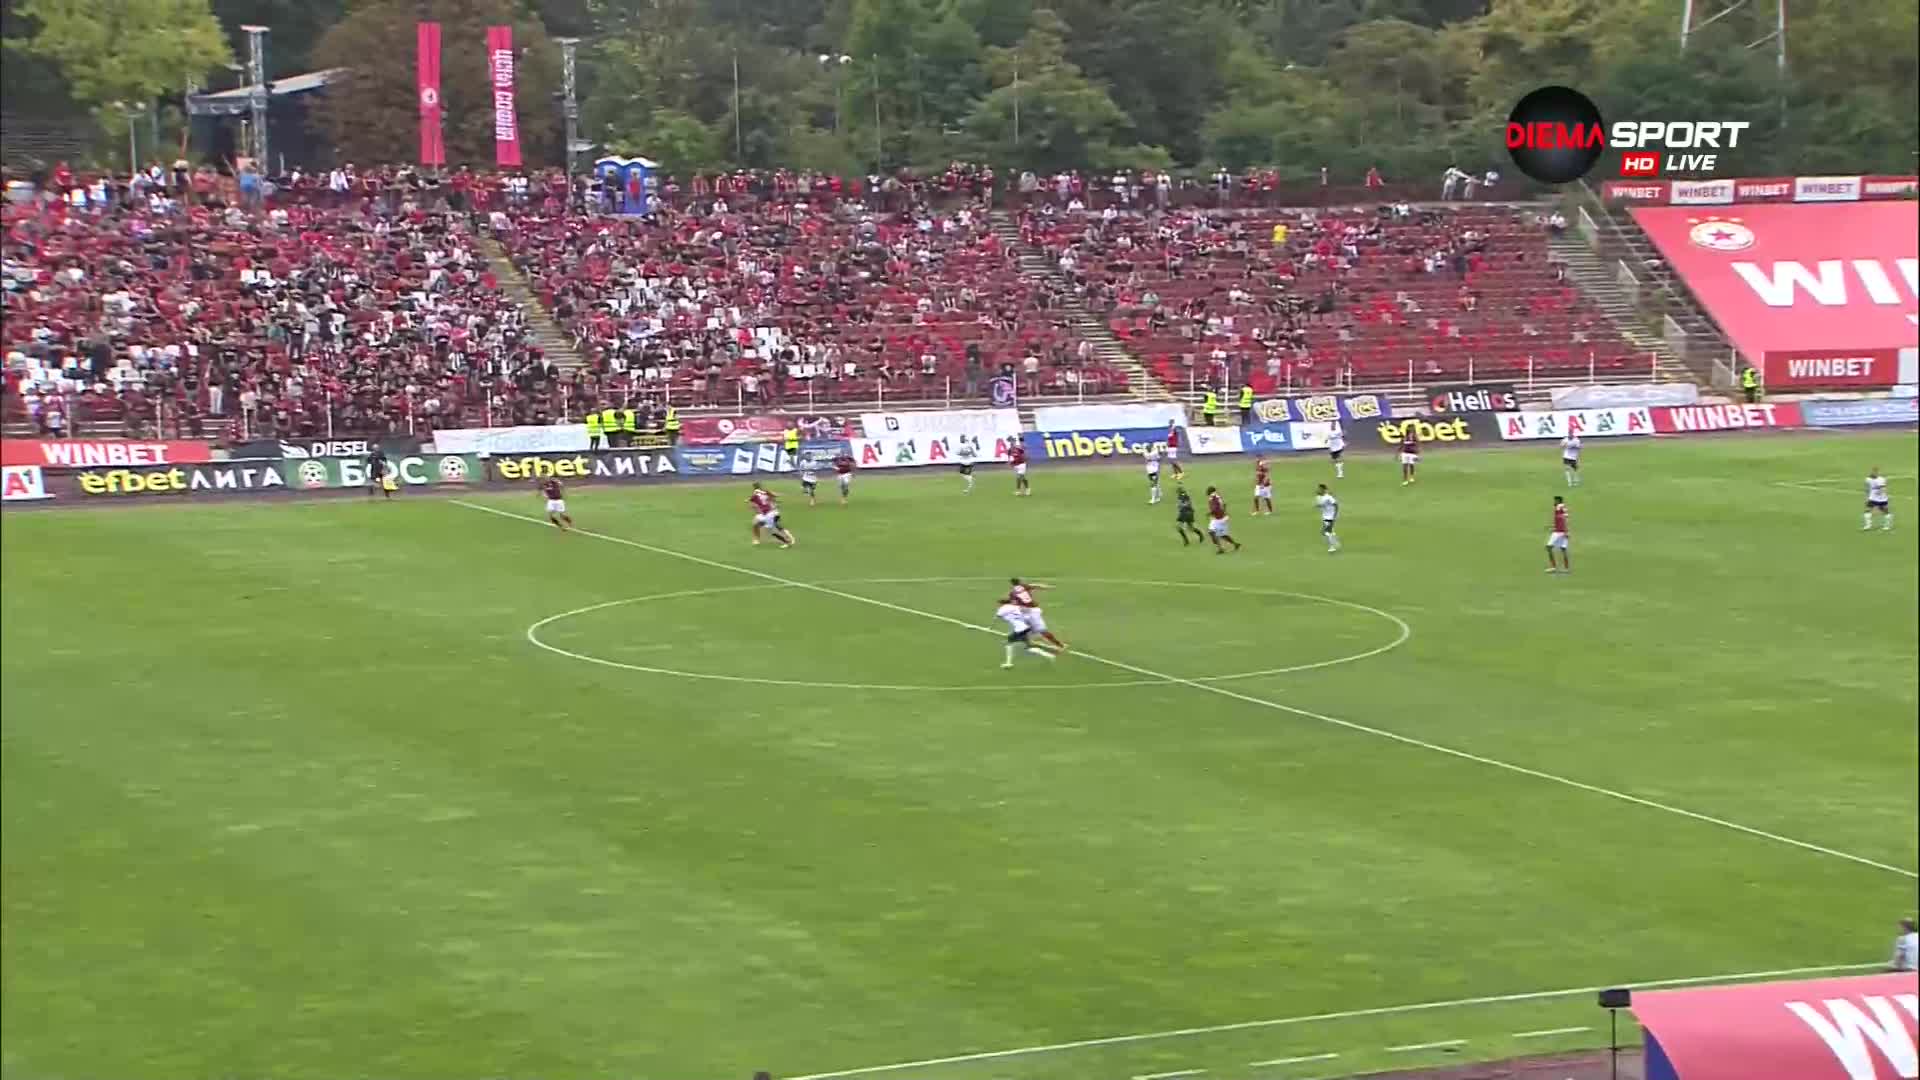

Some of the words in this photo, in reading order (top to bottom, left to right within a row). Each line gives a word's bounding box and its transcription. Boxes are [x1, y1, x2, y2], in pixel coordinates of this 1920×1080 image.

[1612, 186, 1662, 199] WINBET
[1677, 185, 1729, 199] WINBET
[1739, 183, 1791, 197] WINBET
[1801, 181, 1854, 196] WINBET
[1730, 259, 1919, 307] WI
[1788, 358, 1875, 378] WINBET
[1448, 390, 1516, 412] Helios
[1670, 404, 1777, 431] WINBET
[41, 442, 169, 465] WINBET
[312, 441, 372, 457] DIESEL
[497, 454, 591, 479] efbet
[594, 455, 677, 477] ЛИГА
[4, 469, 34, 495] A1
[79, 467, 188, 494] efbet
[191, 467, 285, 491] ЛИГА
